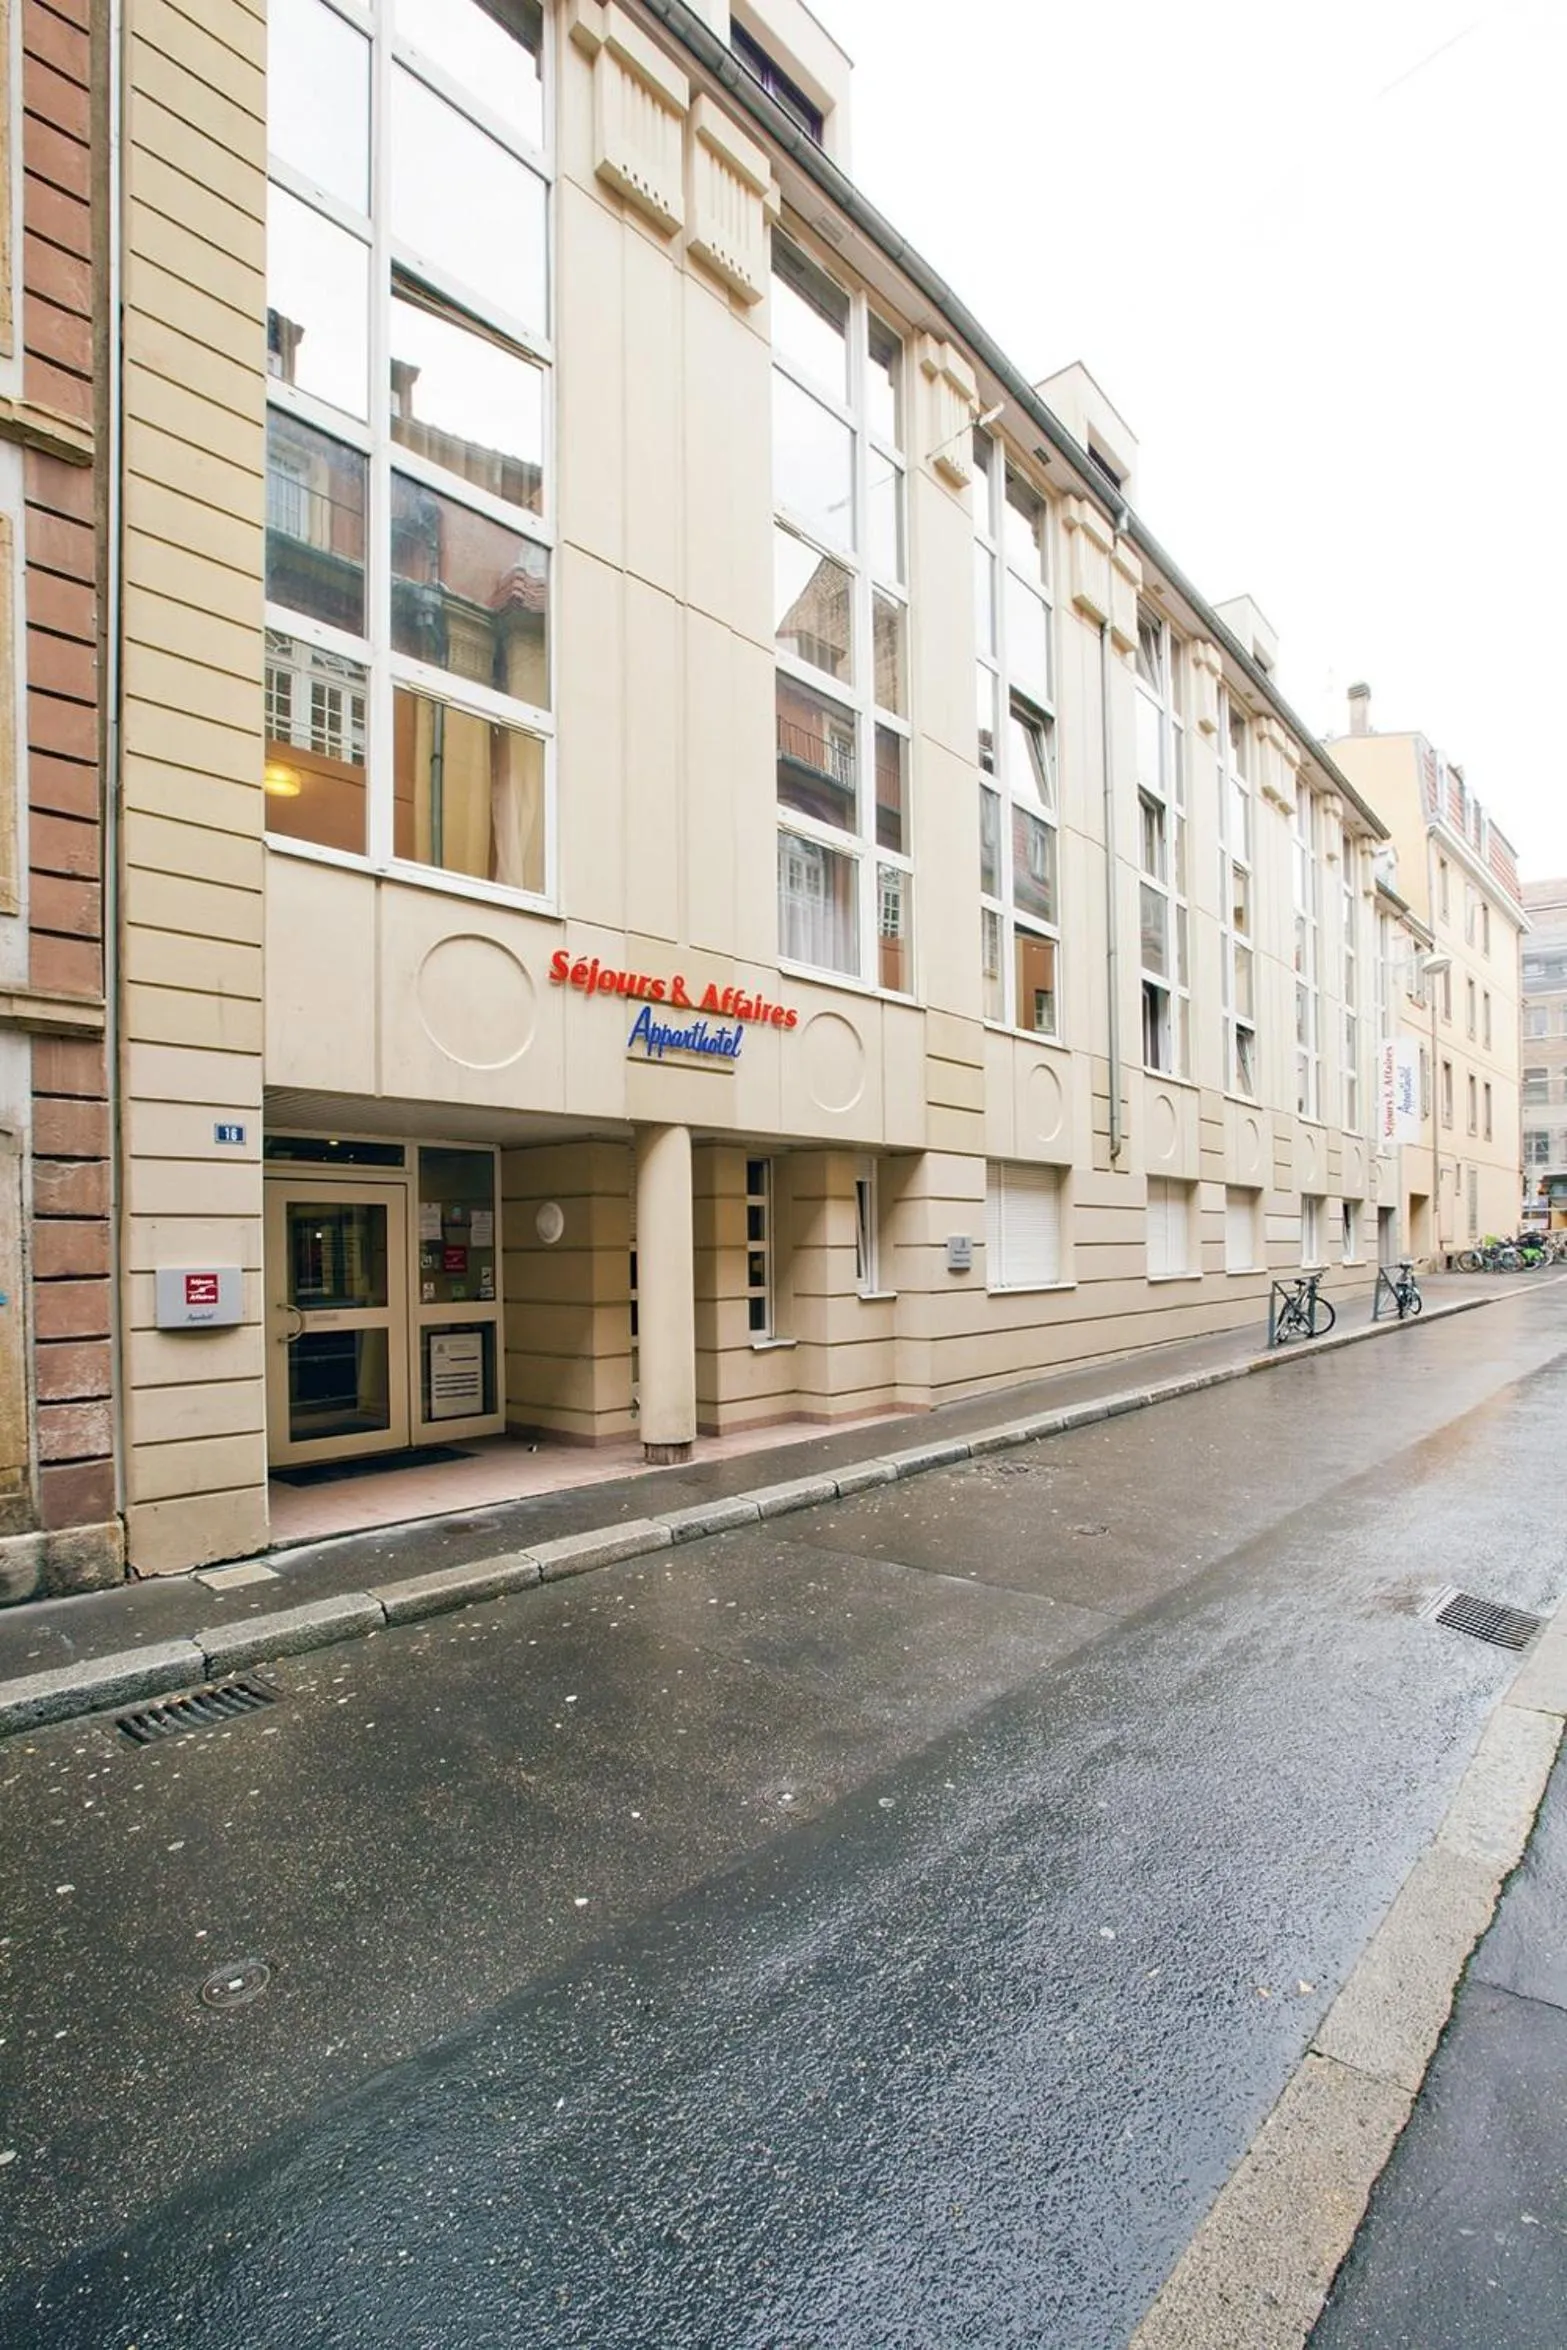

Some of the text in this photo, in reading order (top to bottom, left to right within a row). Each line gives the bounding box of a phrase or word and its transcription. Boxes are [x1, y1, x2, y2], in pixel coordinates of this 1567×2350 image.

[549, 950, 798, 1028] Séjours & Affaires
